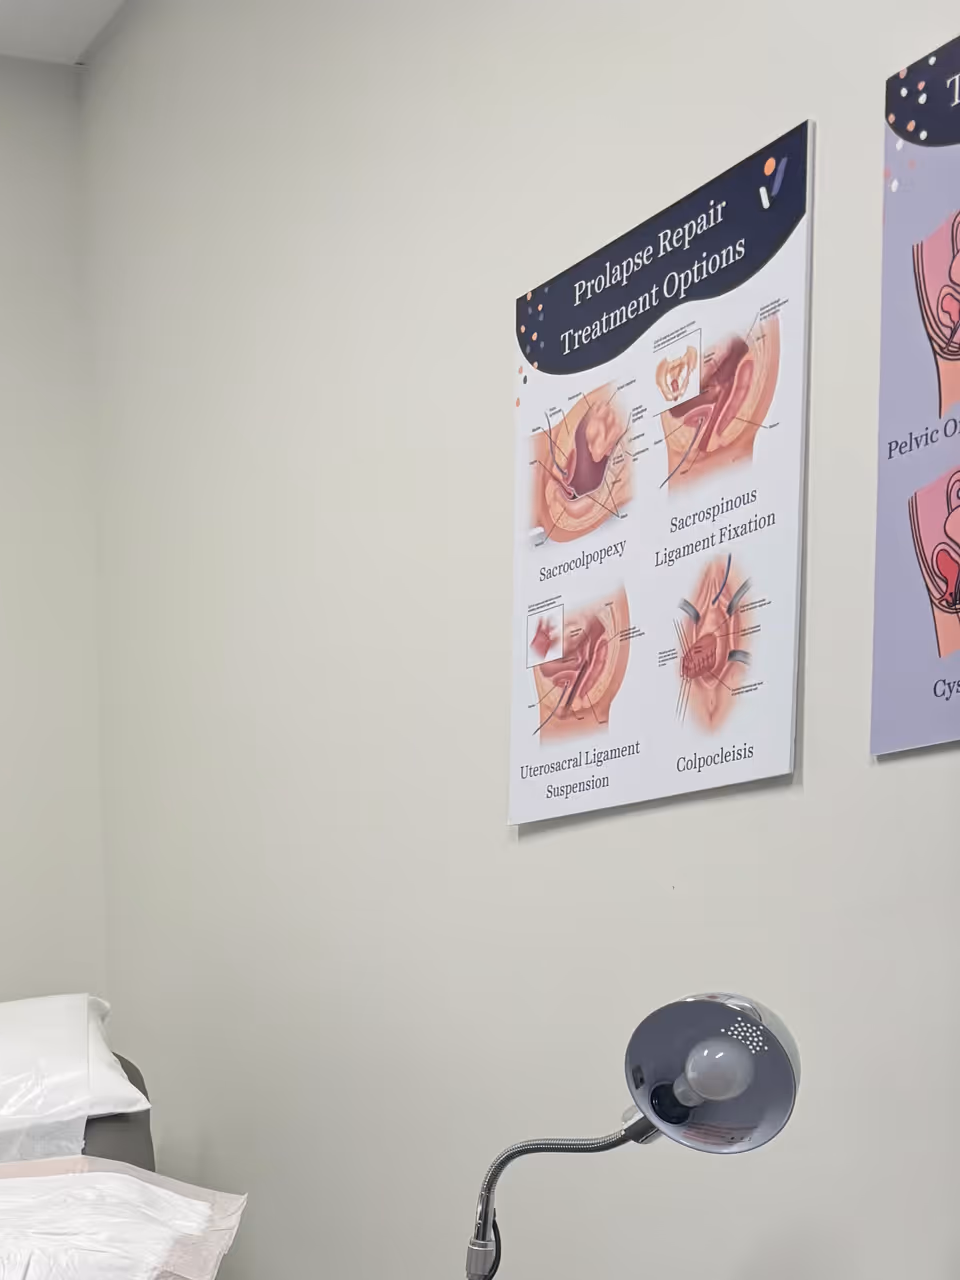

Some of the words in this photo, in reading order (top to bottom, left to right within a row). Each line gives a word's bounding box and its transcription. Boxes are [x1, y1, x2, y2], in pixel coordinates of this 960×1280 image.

[573, 245, 653, 306] Prolapse
[657, 200, 727, 258] Repair
[560, 284, 659, 356] Treatment
[663, 238, 746, 299] Options
[887, 426, 940, 460] Pelvic
[669, 490, 757, 534] Sacrospinous
[539, 538, 627, 582] Sacrocolpopexy
[654, 532, 716, 568] Ligament
[719, 511, 776, 547] Fixation
[520, 753, 582, 780] Uterosacral
[584, 740, 641, 768] Ligament
[676, 743, 754, 773] Colpocleisis
[546, 774, 610, 799] Suspension
